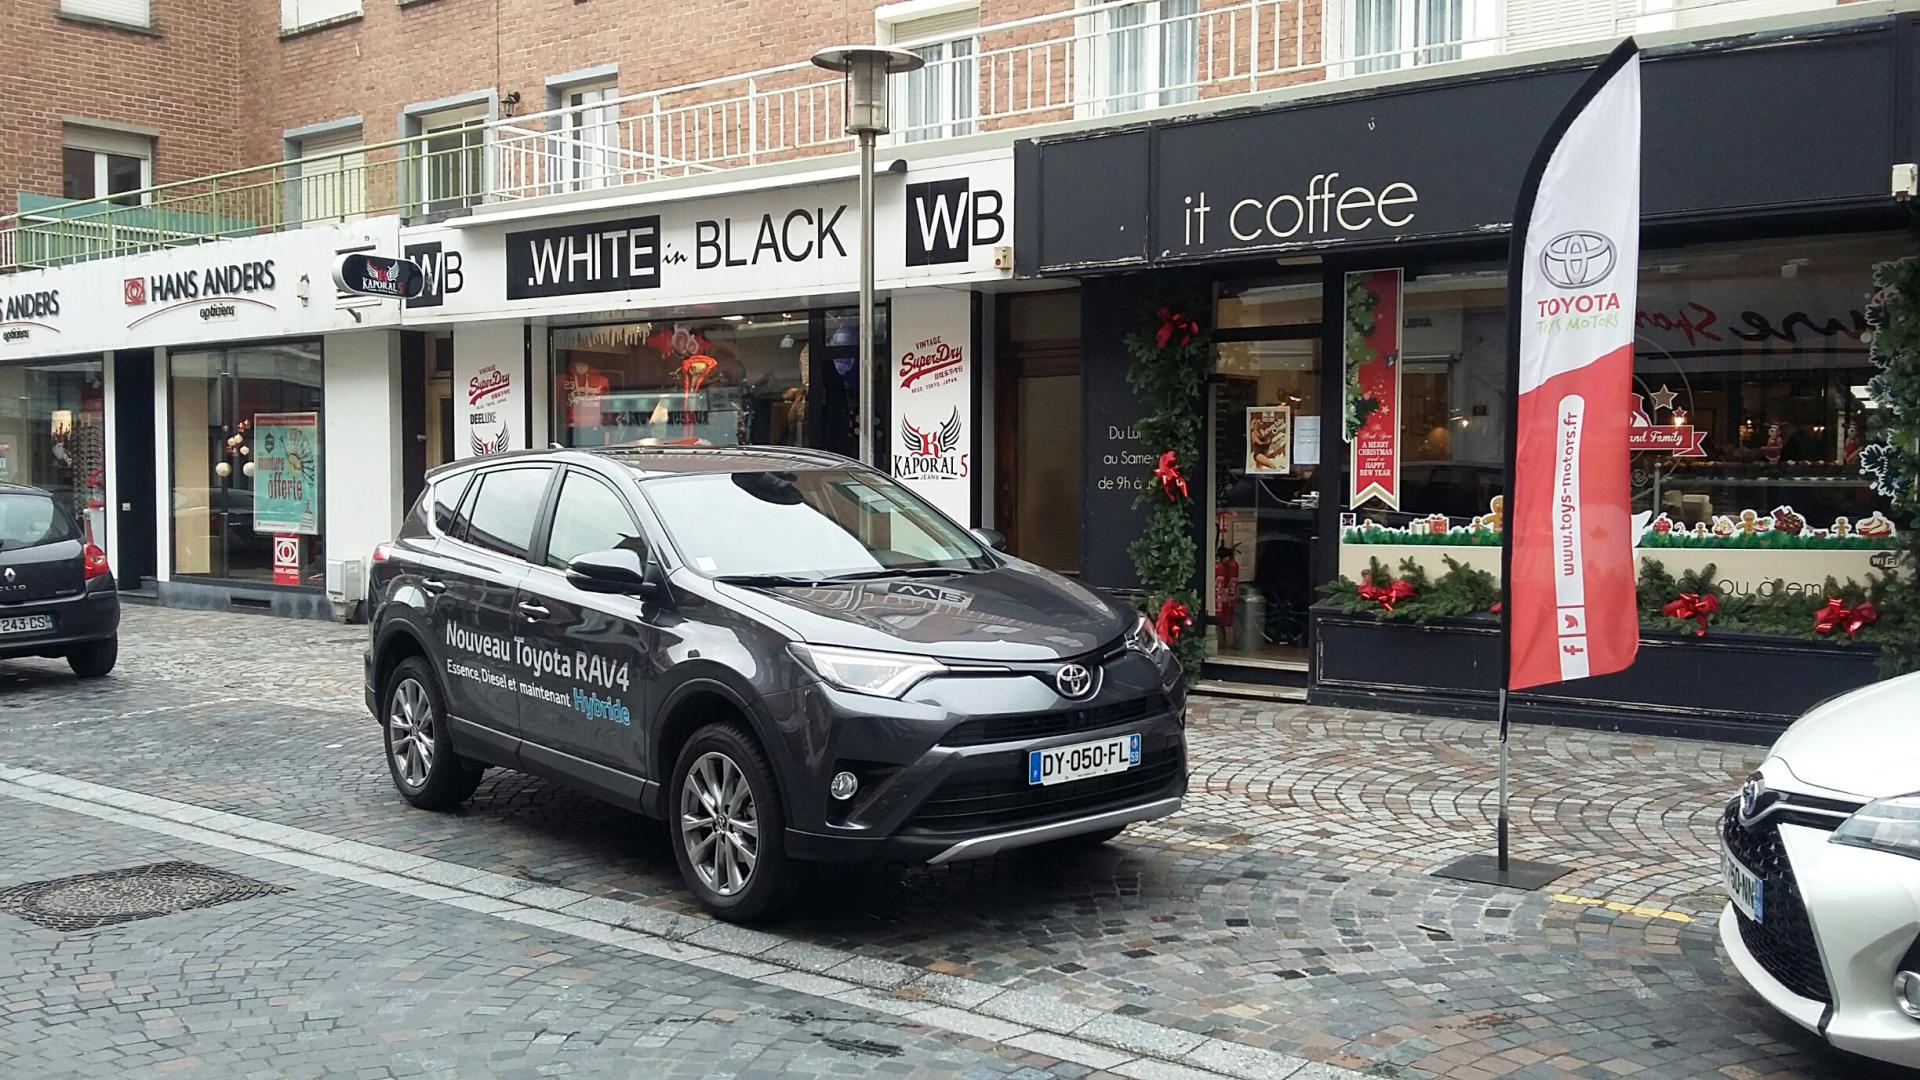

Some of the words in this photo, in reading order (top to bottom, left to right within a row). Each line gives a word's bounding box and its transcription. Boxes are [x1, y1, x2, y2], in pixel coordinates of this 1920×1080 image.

[1184, 191, 1211, 245] it
[1229, 172, 1418, 241] coffee
[915, 189, 1005, 252] WB
[661, 243, 688, 265] in
[696, 204, 848, 270] BLACK
[150, 269, 199, 302] HANS
[202, 259, 276, 296] ANDERS
[410, 250, 464, 297] WB
[362, 277, 398, 292] KAPORAL
[5, 289, 60, 320] ANDERS
[199, 303, 236, 321] opticiens
[1537, 292, 1620, 318] TOYOTA
[1567, 313, 1619, 331] MOTORS
[915, 335, 942, 350] VINTAGE
[1109, 425, 1125, 440] Du
[1649, 431, 1684, 447] Family
[1358, 448, 1393, 456] CHRISTMAS
[1361, 441, 1367, 449] A
[1367, 441, 1390, 449] MERRY
[893, 454, 958, 479] KAPORAL
[959, 453, 969, 478] 5
[1103, 454, 1118, 465] au
[1120, 450, 1154, 465] Same
[1365, 461, 1386, 469] HAPPY
[1359, 469, 1374, 477] NEW
[1374, 469, 1392, 477] YEAR
[1097, 476, 1114, 490] de
[1116, 476, 1131, 490] 9h
[1560, 411, 1578, 577] www.toys-motors.fr
[446, 618, 511, 662] Nouveau
[514, 635, 571, 678] Toyota
[575, 650, 630, 693] RAV4
[446, 658, 482, 684] Essence,
[481, 667, 508, 689] Diesel
[507, 678, 518, 692] et
[519, 682, 571, 708] maintenant
[572, 687, 631, 726] Hybride
